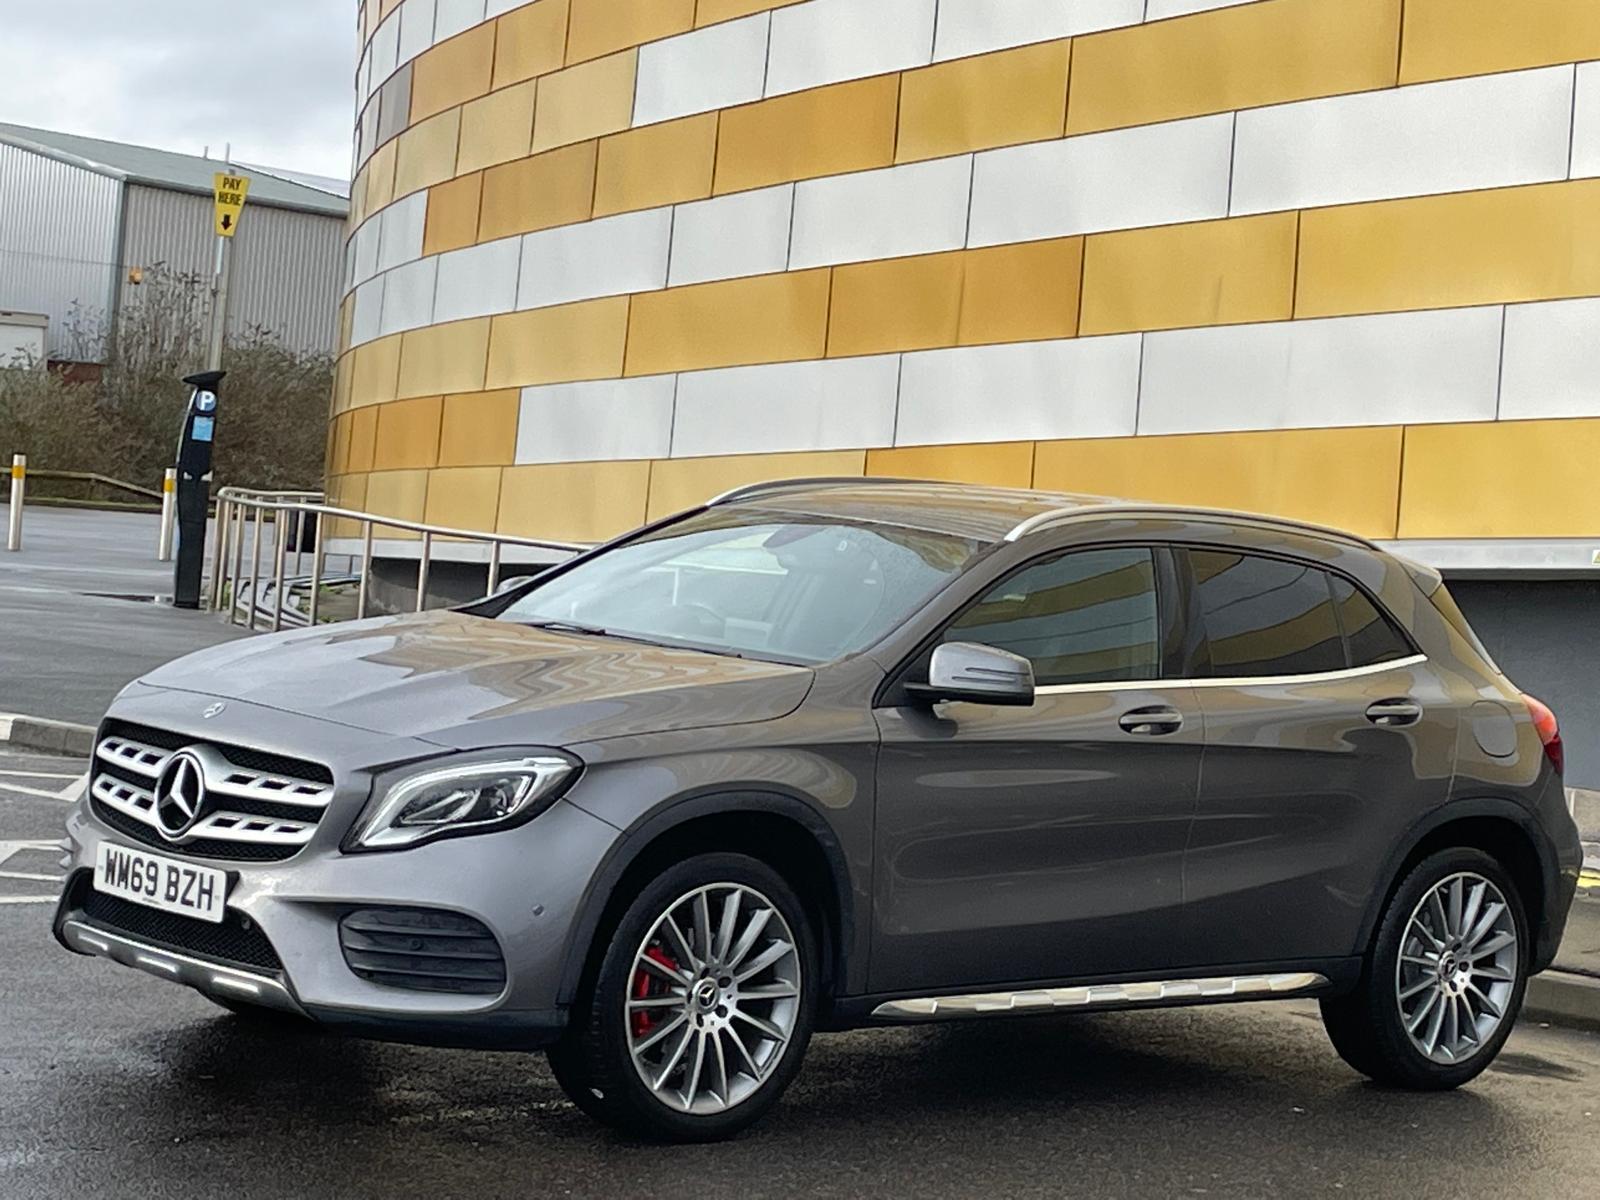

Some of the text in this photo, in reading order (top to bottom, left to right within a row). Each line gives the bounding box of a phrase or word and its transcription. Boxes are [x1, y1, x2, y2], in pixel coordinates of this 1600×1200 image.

[223, 177, 242, 190] PAY
[218, 191, 242, 206] HERE
[200, 391, 215, 411] P
[104, 848, 215, 911] WM69 BZH
